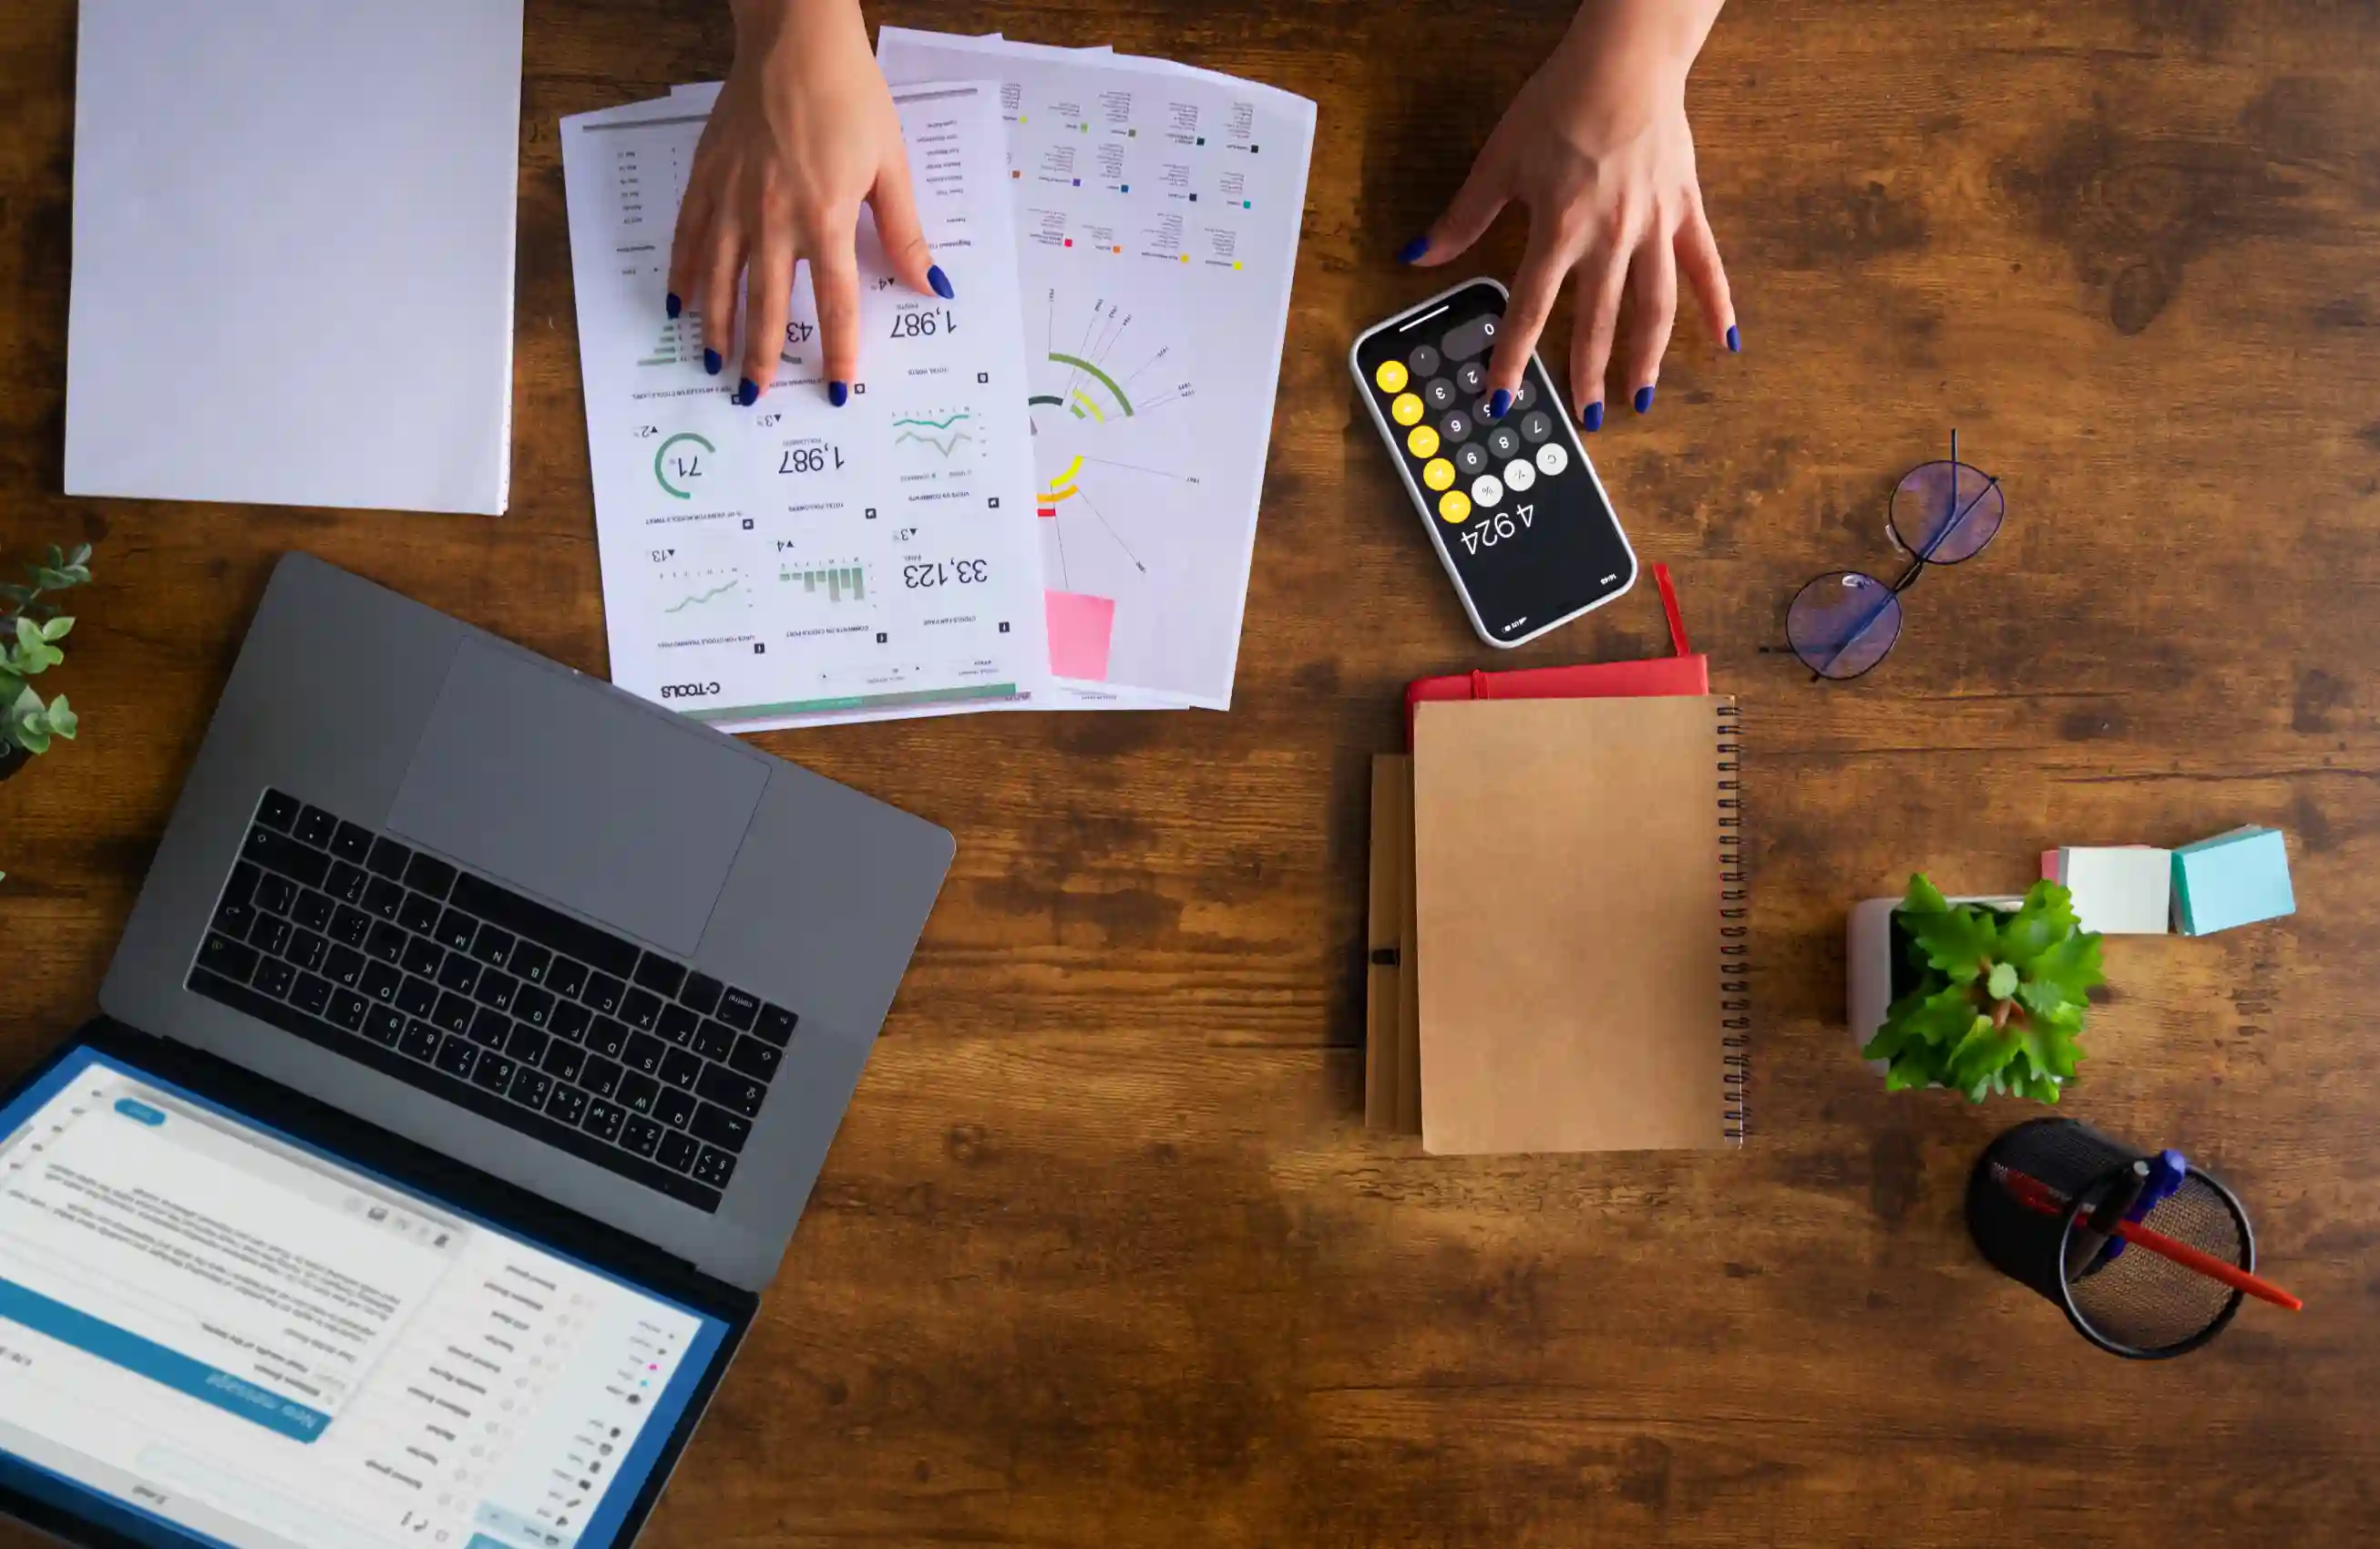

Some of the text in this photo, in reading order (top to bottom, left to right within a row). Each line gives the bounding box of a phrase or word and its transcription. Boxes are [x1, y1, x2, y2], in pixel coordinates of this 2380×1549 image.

[891, 308, 956, 338] 1,987
[1484, 323, 1494, 335] 0
[1436, 371, 1478, 399] 2 3
[1451, 420, 1462, 432] 6
[1467, 420, 1543, 465] 7 8 9
[779, 445, 844, 474] 1,987
[1547, 455, 1556, 464] C
[1462, 513, 1515, 554] 924
[904, 559, 987, 589] 33,123
[456, 935, 466, 947] M
[493, 951, 503, 962] N
[344, 973, 354, 982] P
[531, 968, 539, 979] B
[381, 988, 390, 998] O
[566, 984, 574, 994] V
[603, 999, 612, 1010] C
[728, 995, 753, 1008] control
[390, 948, 690, 1084] A S D F G H J K L
[641, 1015, 649, 1026] X
[454, 1019, 463, 1029] U
[491, 1036, 498, 1045] Y
[677, 1031, 686, 1042] Z
[528, 1051, 536, 1062] T
[565, 1066, 573, 1077] R
[601, 1082, 610, 1093] E
[635, 1097, 646, 1108] W
[674, 1113, 683, 1123] Q
